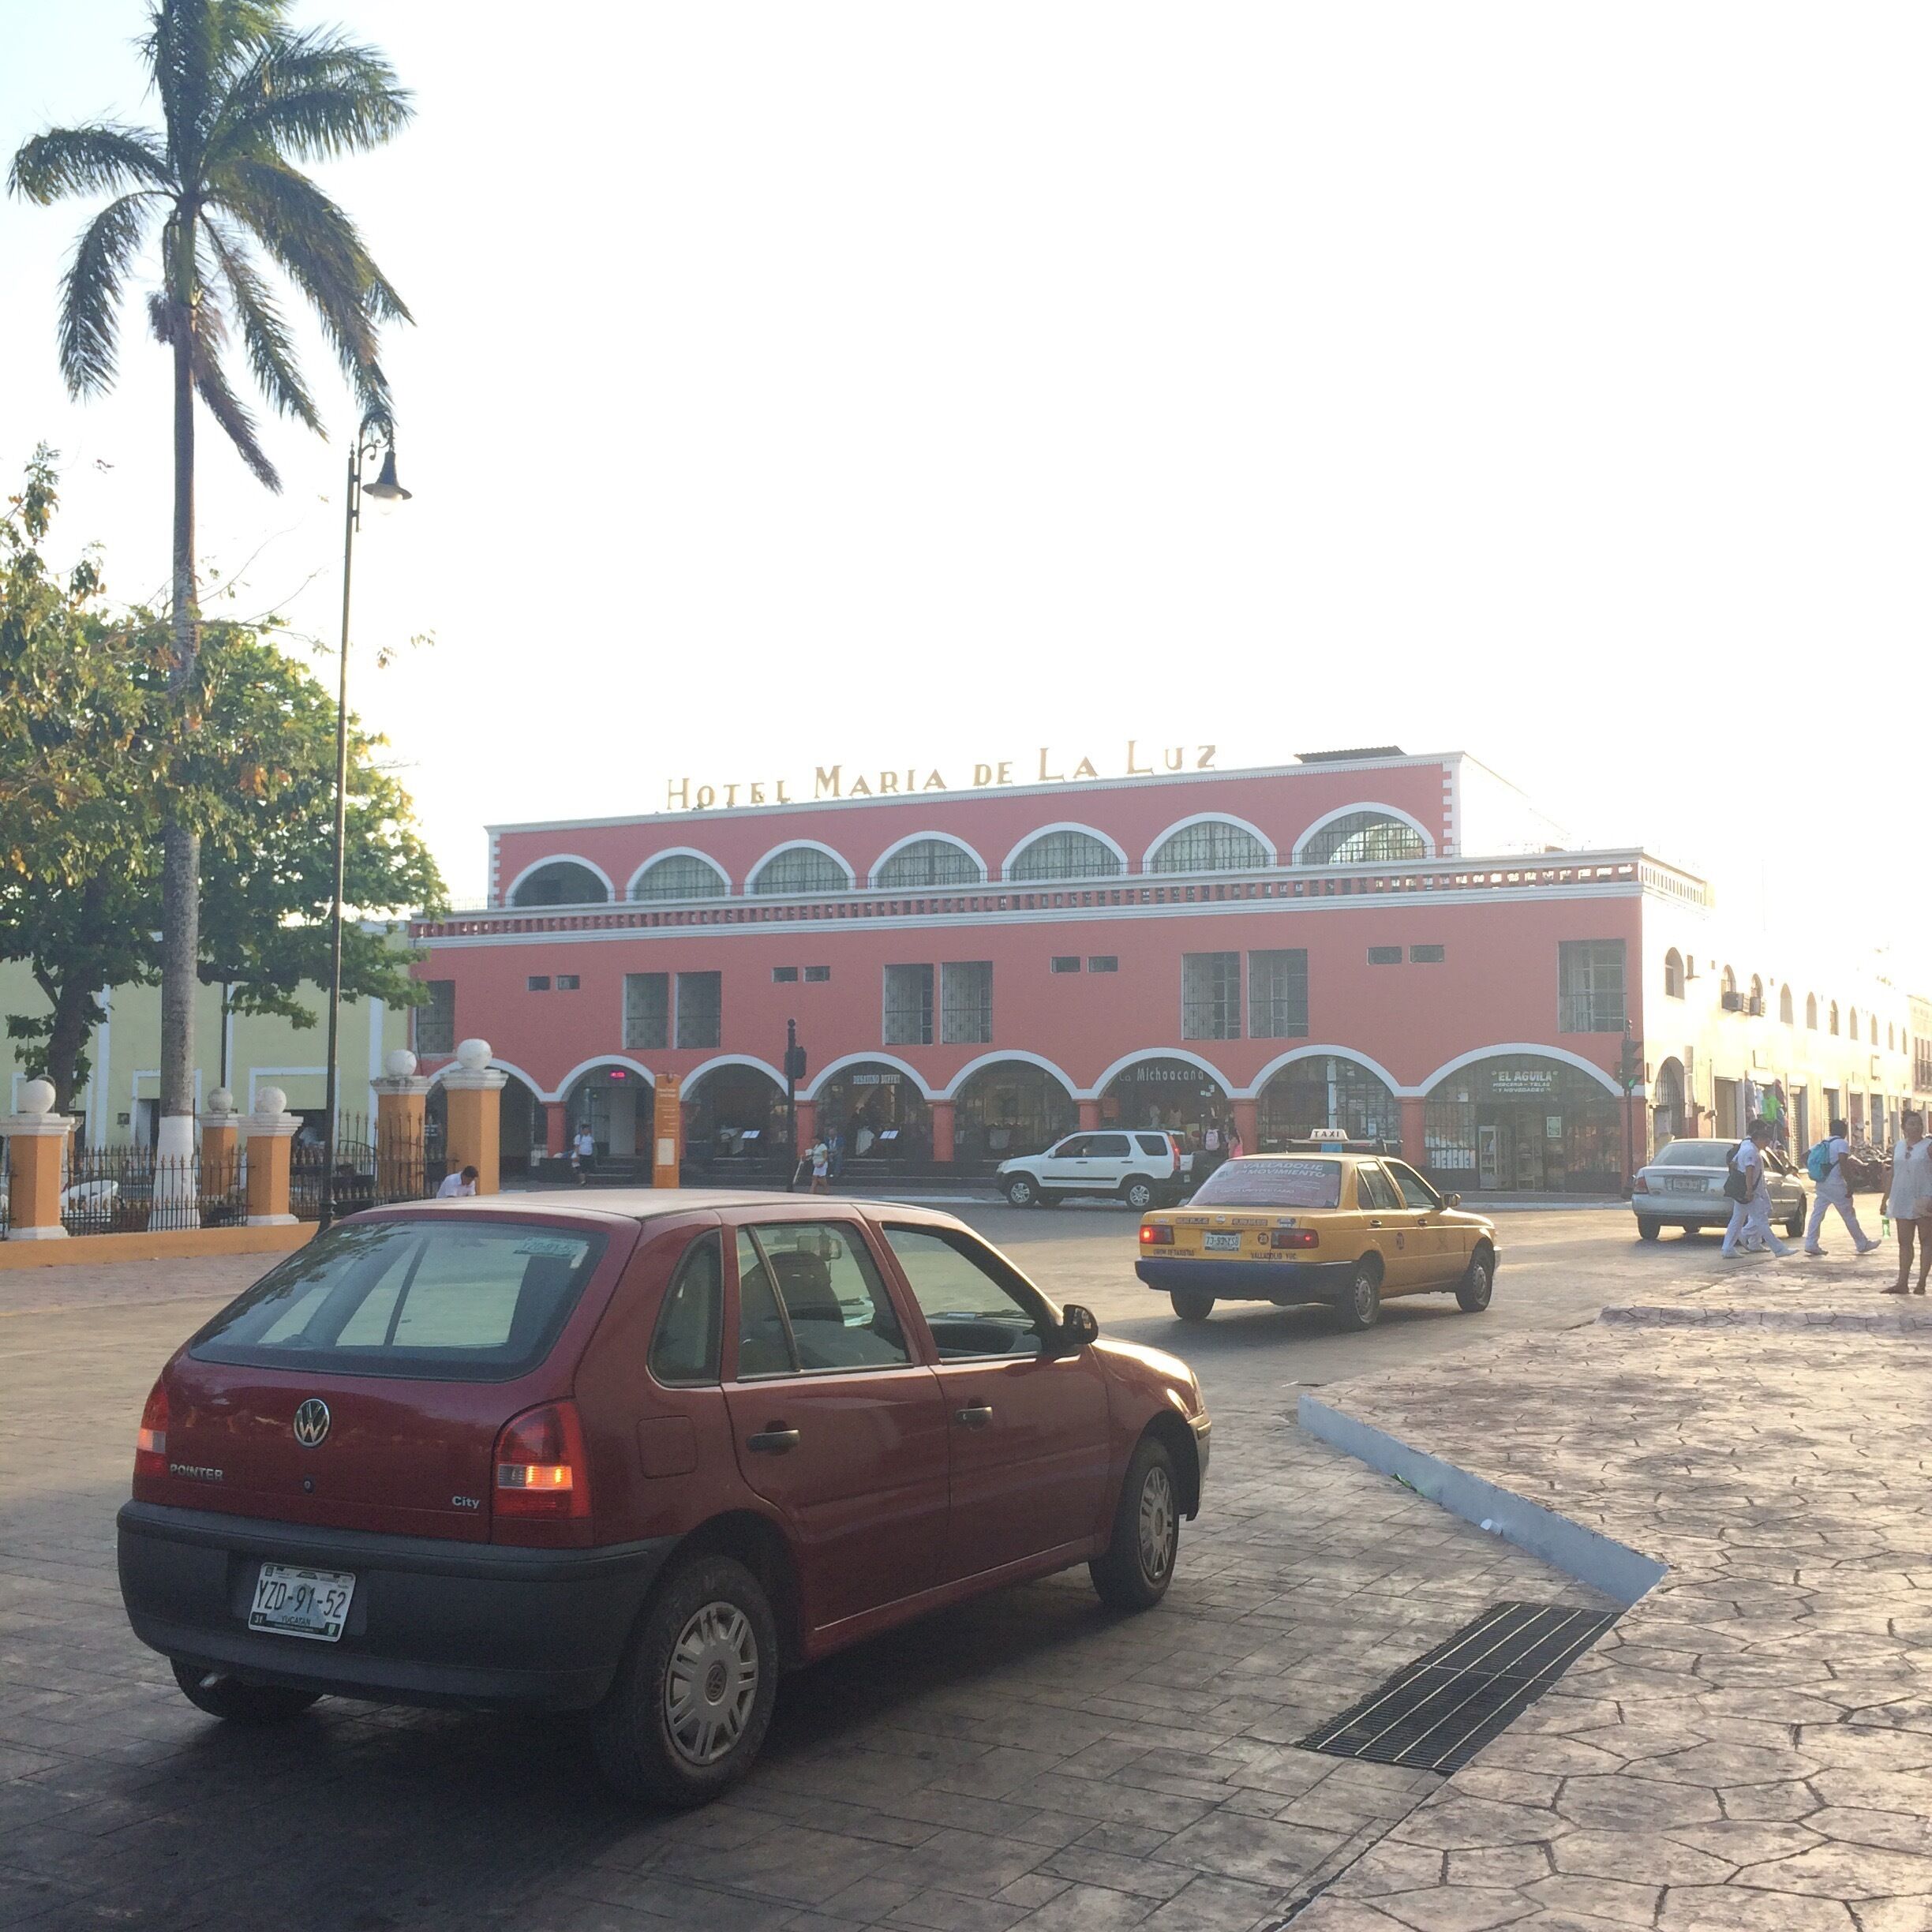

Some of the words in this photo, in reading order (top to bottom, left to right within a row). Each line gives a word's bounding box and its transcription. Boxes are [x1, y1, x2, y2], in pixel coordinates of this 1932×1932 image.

[667, 777, 791, 810] HOTEL
[814, 765, 947, 799] MARIA
[972, 761, 1013, 786] DE
[1038, 747, 1099, 781] LA
[1126, 739, 1216, 775] LUZ
[1246, 1168, 1326, 1178] MOVIMIENTO
[169, 1462, 224, 1480] POINTER
[452, 1496, 480, 1509] City
[257, 1579, 346, 1618] YZD-91-52
